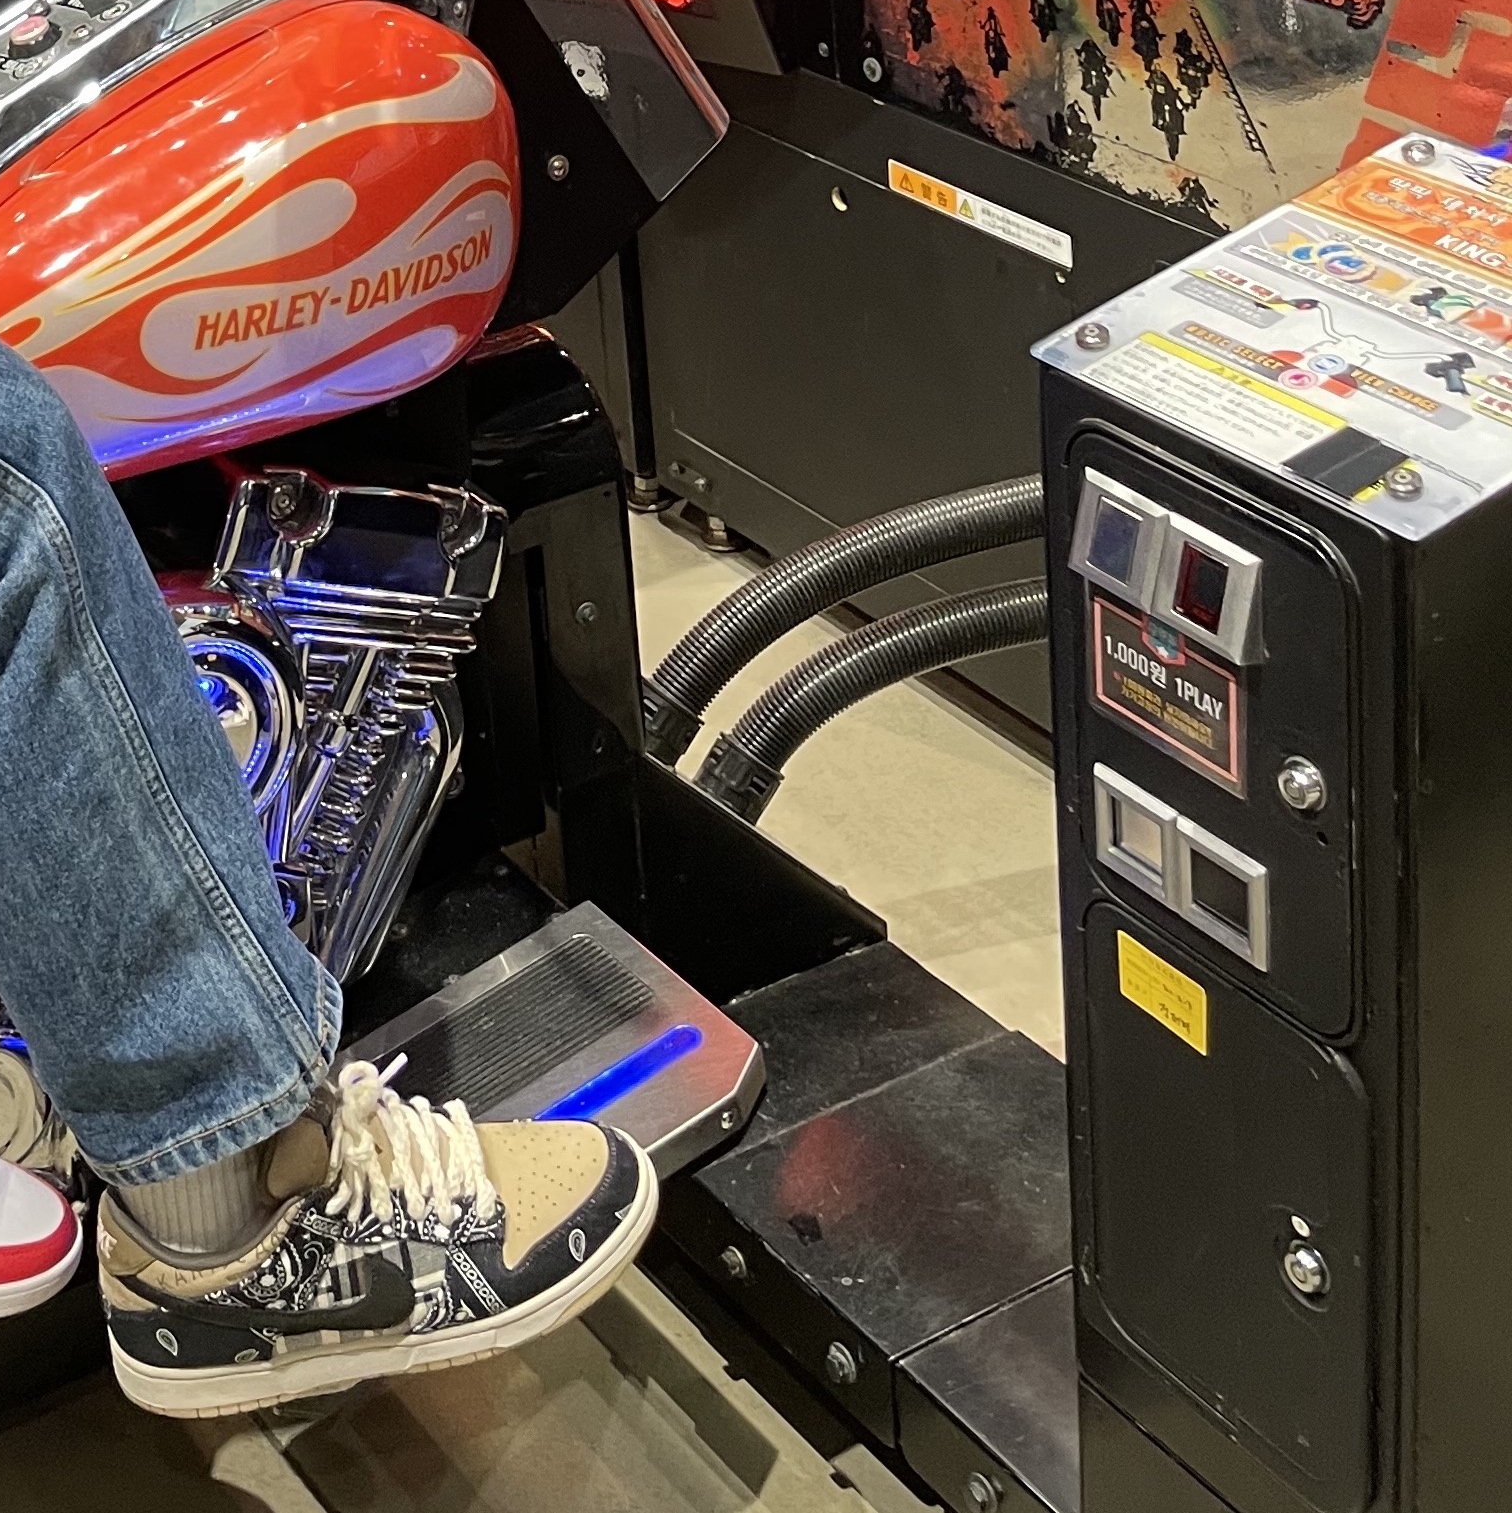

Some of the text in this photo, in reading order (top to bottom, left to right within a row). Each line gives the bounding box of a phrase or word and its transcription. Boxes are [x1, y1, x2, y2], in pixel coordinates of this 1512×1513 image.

[1434, 234, 1507, 268] KING
[194, 226, 491, 351] HARLEY-DAVIDSON
[1231, 342, 1285, 370] SELECT
[1174, 677, 1224, 721] 1PLAY
